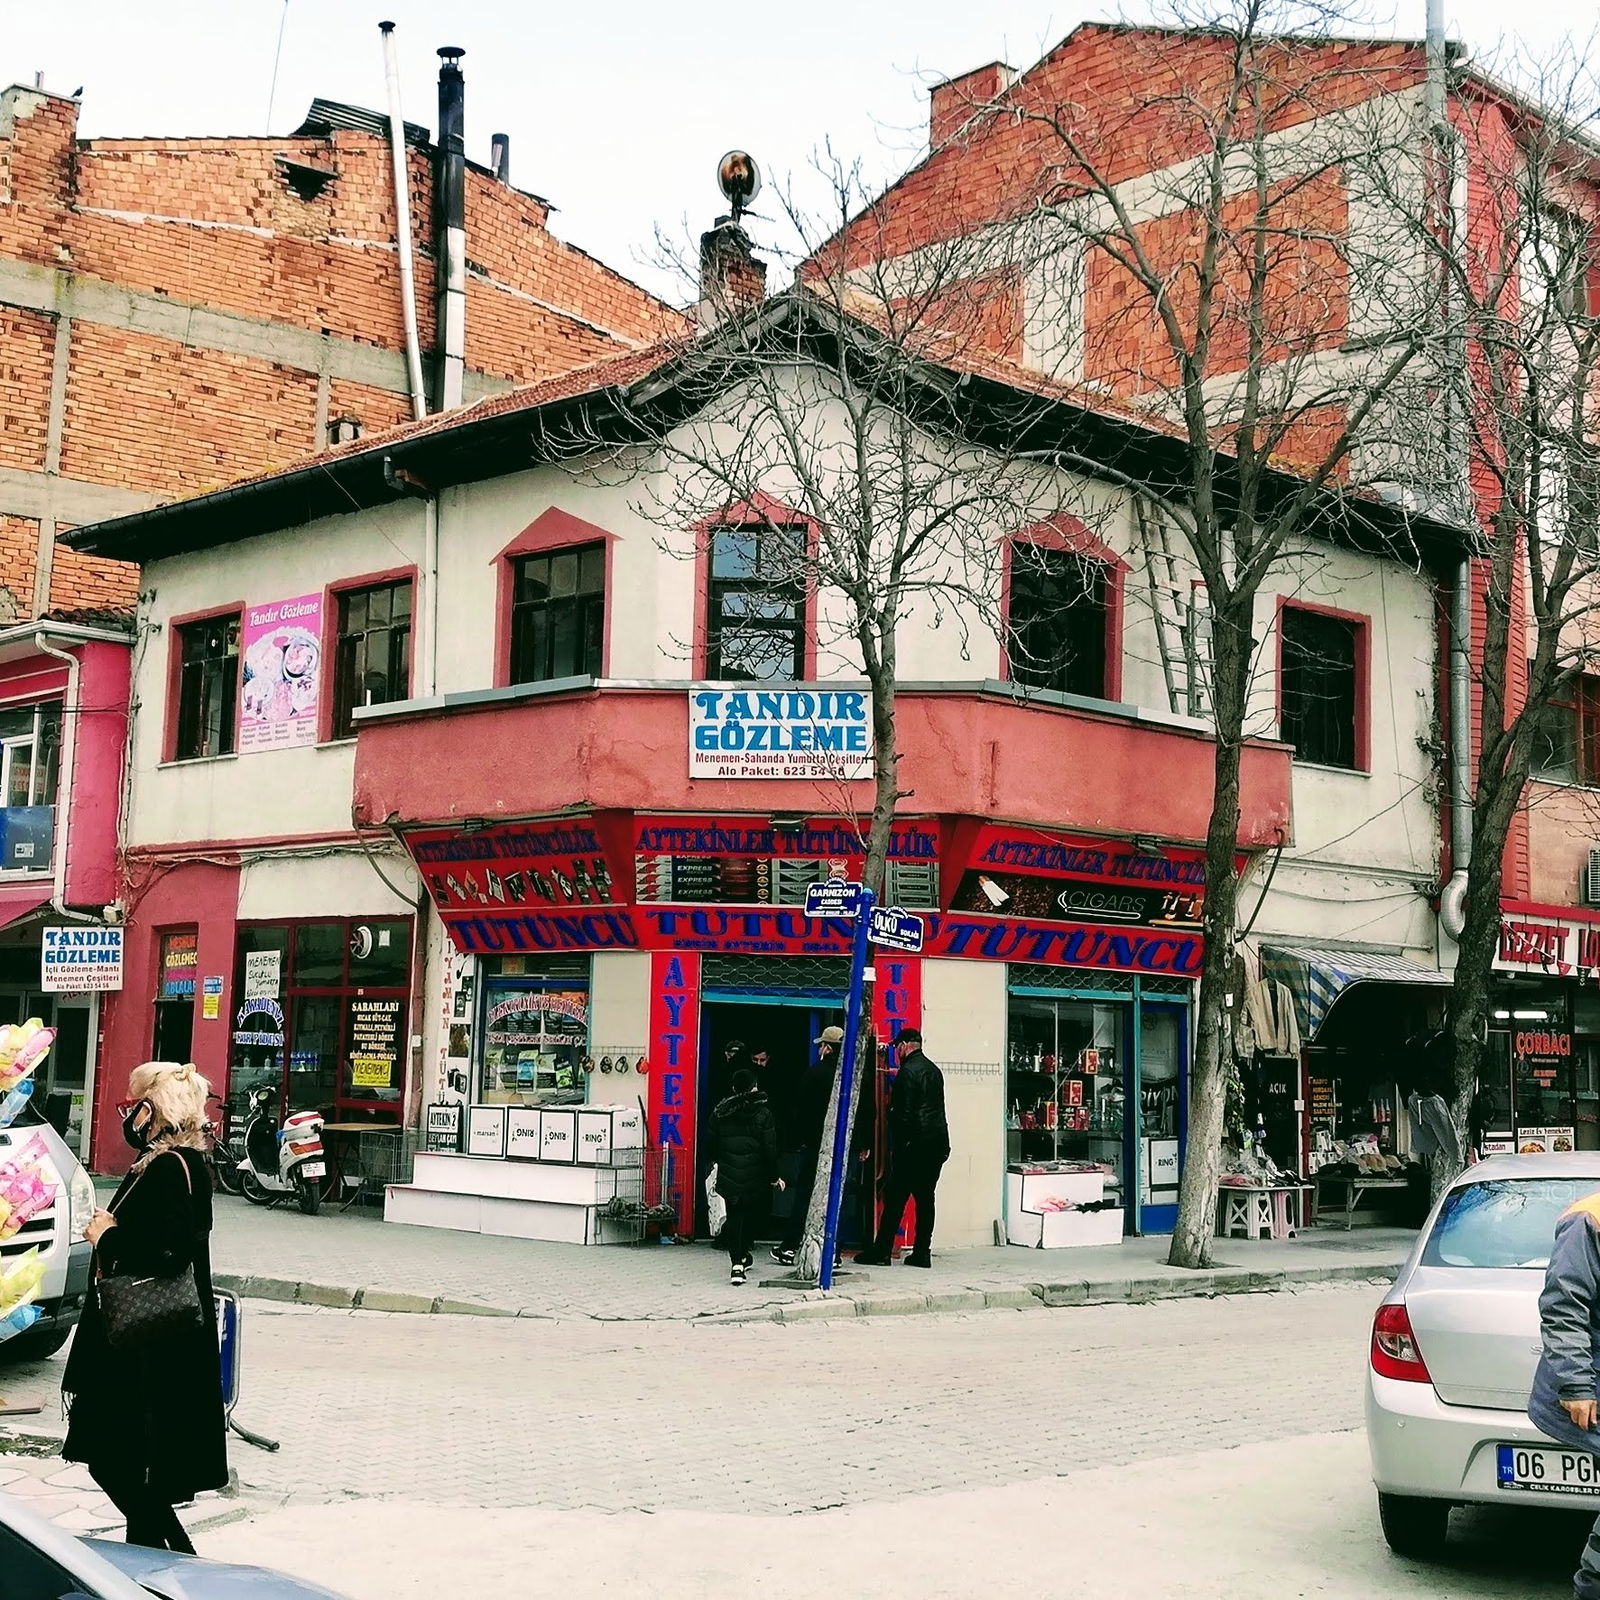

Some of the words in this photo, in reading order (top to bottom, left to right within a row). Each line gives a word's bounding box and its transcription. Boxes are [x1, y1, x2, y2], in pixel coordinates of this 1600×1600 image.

[250, 607, 278, 627] Tandır
[280, 602, 319, 620] Gözleme
[695, 692, 867, 721] TANDIR
[695, 720, 867, 751] GÖZLEME
[695, 753, 785, 765] Menemen-Sahanda
[718, 767, 736, 776] Alo
[741, 767, 779, 776] Paket:
[784, 767, 806, 776] 623
[811, 767, 826, 776] 54
[636, 820, 777, 854] AYTEKİNLER
[781, 823, 938, 858] TÜTÜNLÜK
[1067, 890, 1147, 914] CIGARS
[874, 911, 897, 935] ÜLKÜ
[46, 931, 121, 946] TANDIR
[1499, 921, 1569, 966] LEZZET
[1578, 928, 1600, 969] LO
[45, 946, 120, 964] GÖZLEME
[87, 974, 119, 983] Çeşitleri
[441, 931, 454, 1030] IYAMAN
[1516, 1032, 1570, 1060] ÇORBACI
[452, 1111, 458, 1129] 2
[516, 1128, 535, 1138] RING
[549, 1131, 567, 1141] RING
[585, 1134, 603, 1143] RING
[1484, 1143, 1506, 1151] stadan
[1158, 1158, 1174, 1166] RING
[1502, 1466, 1513, 1475] TR
[1516, 1452, 1545, 1479] 06
